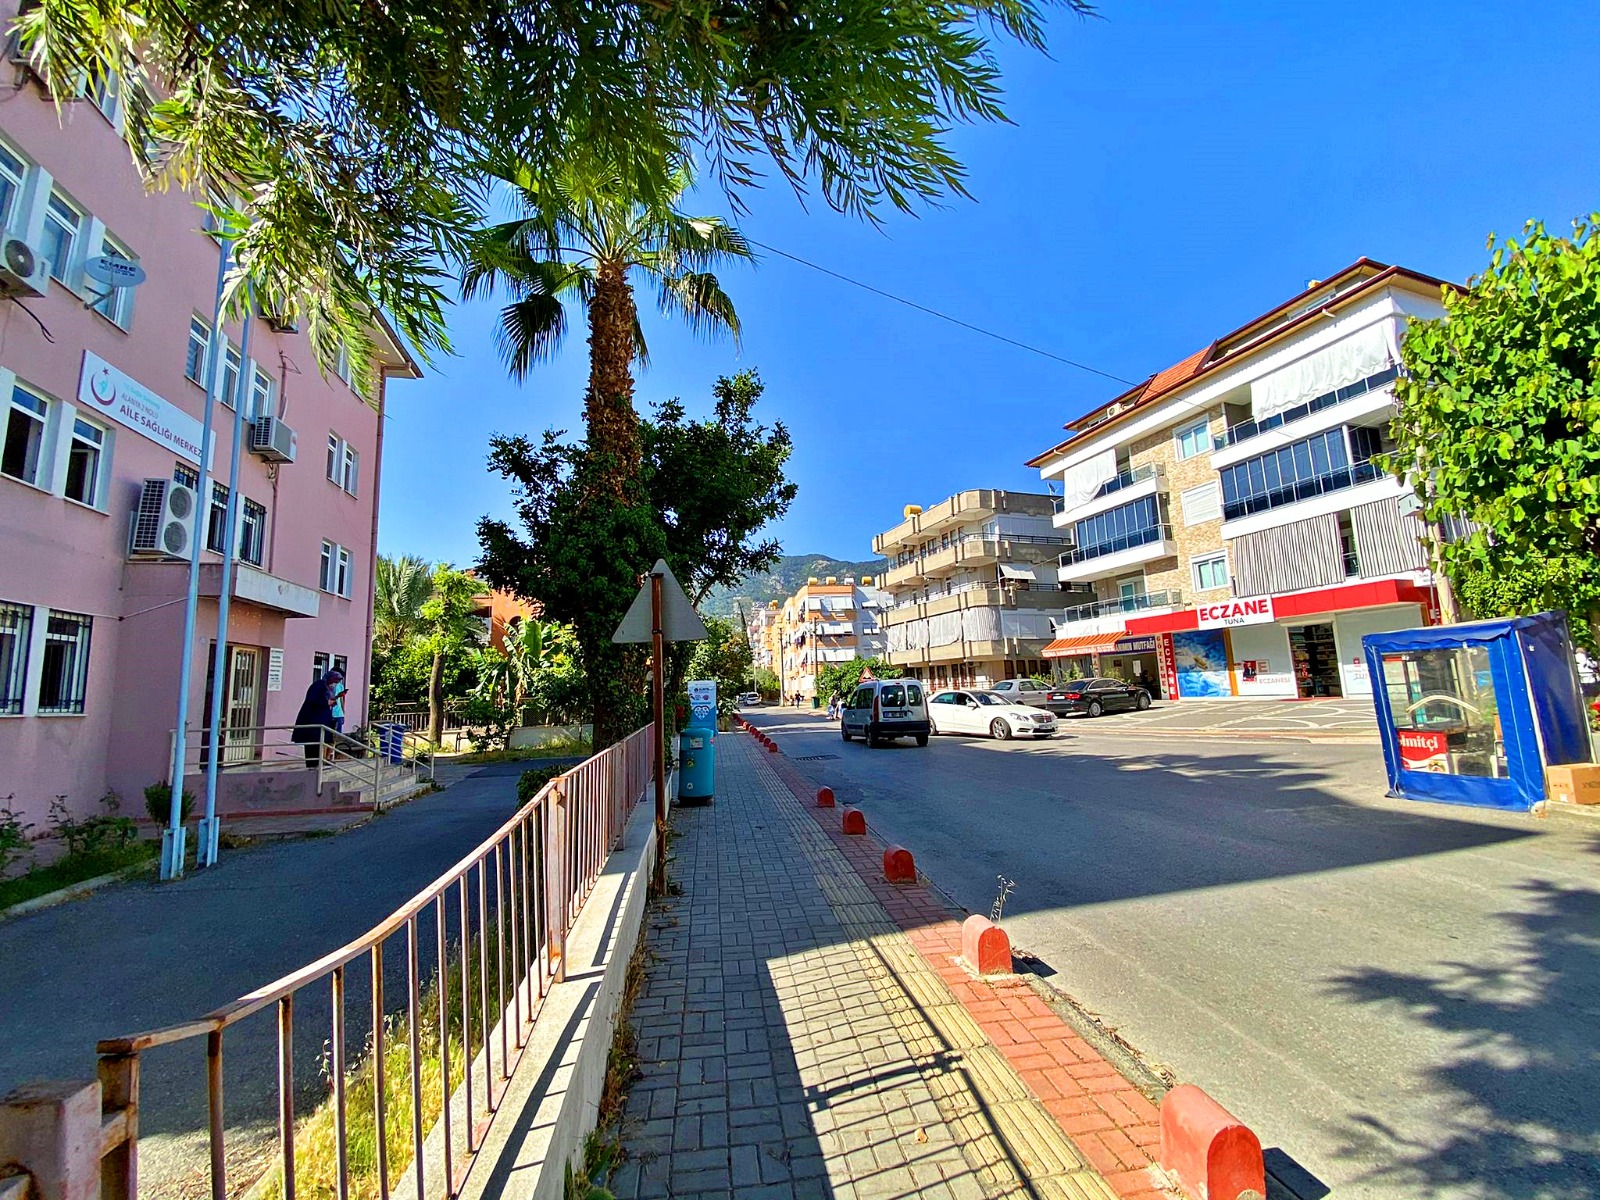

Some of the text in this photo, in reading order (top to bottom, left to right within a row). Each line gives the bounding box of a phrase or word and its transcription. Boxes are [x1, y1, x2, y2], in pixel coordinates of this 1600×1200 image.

[119, 404, 203, 458] AİLE SAĞLIĞI MERKEZ
[1199, 598, 1269, 621] ECZANE
[1224, 616, 1245, 625] TUNA
[1132, 638, 1155, 651] MUTFAĞI
[1164, 638, 1176, 695] ECZANE
[1400, 734, 1438, 752] imitçi
